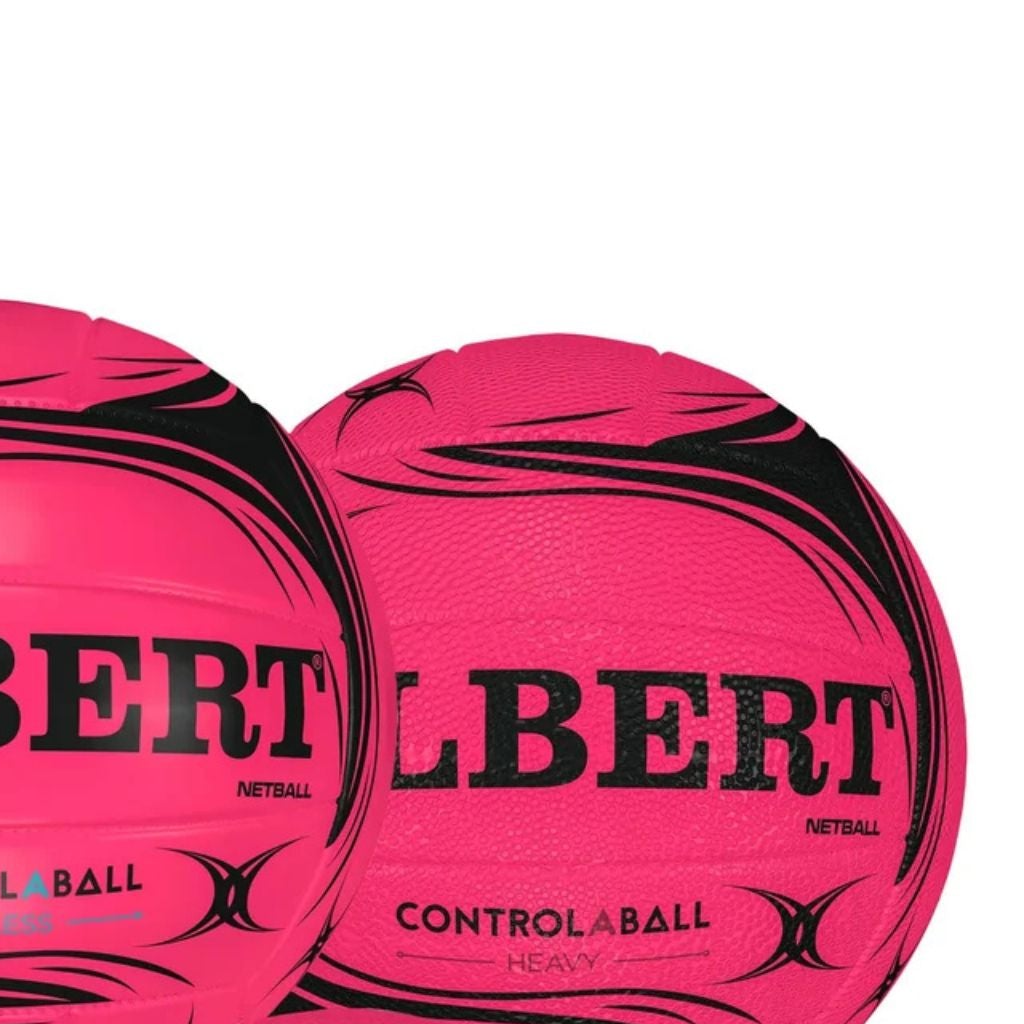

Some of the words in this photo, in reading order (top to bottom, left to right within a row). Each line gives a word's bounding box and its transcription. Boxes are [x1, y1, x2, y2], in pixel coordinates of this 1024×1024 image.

[237, 781, 312, 799] NETBALL
[805, 817, 881, 836] NETBALL
[507, 952, 601, 974] HEAVY
